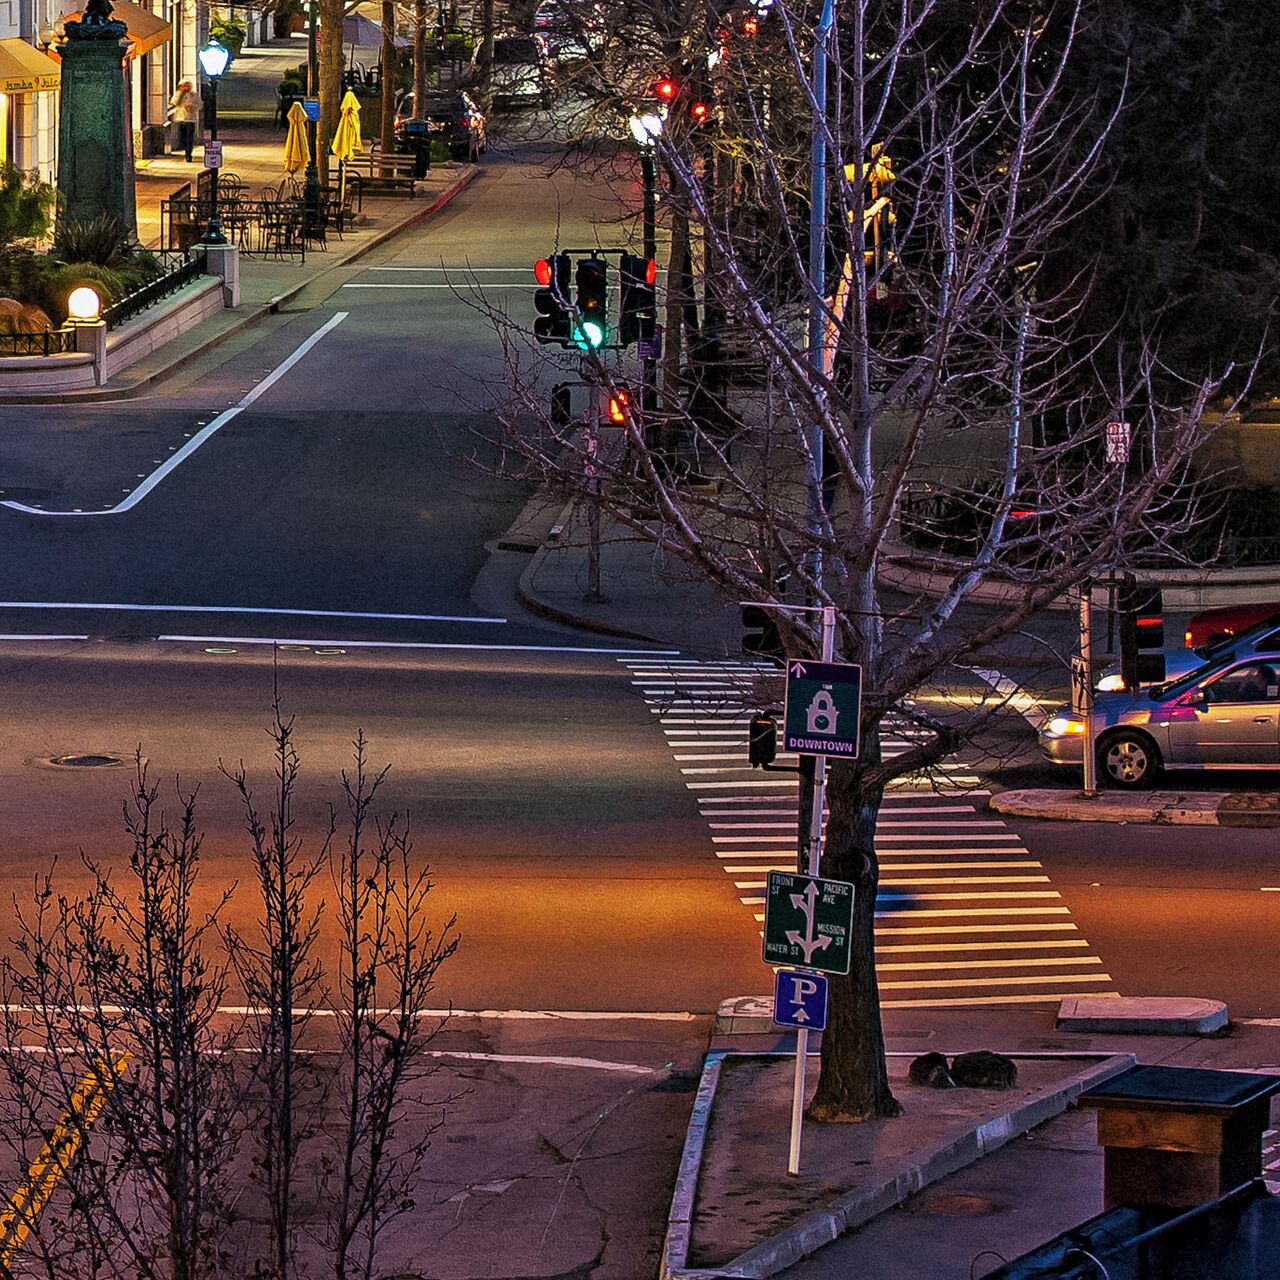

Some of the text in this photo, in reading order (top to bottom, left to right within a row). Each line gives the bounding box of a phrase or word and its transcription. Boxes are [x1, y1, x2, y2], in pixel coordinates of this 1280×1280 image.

[4, 79, 34, 91] Jamba
[789, 738, 853, 753] DOWNTOWN
[772, 875, 794, 887] FRONT
[771, 886, 780, 895] ST
[823, 883, 849, 896] PACIFIC
[822, 894, 836, 905] AVE
[817, 923, 846, 936] MISSION
[835, 937, 844, 946] ST
[766, 942, 799, 956] WATER ST
[789, 977, 817, 1006] P
